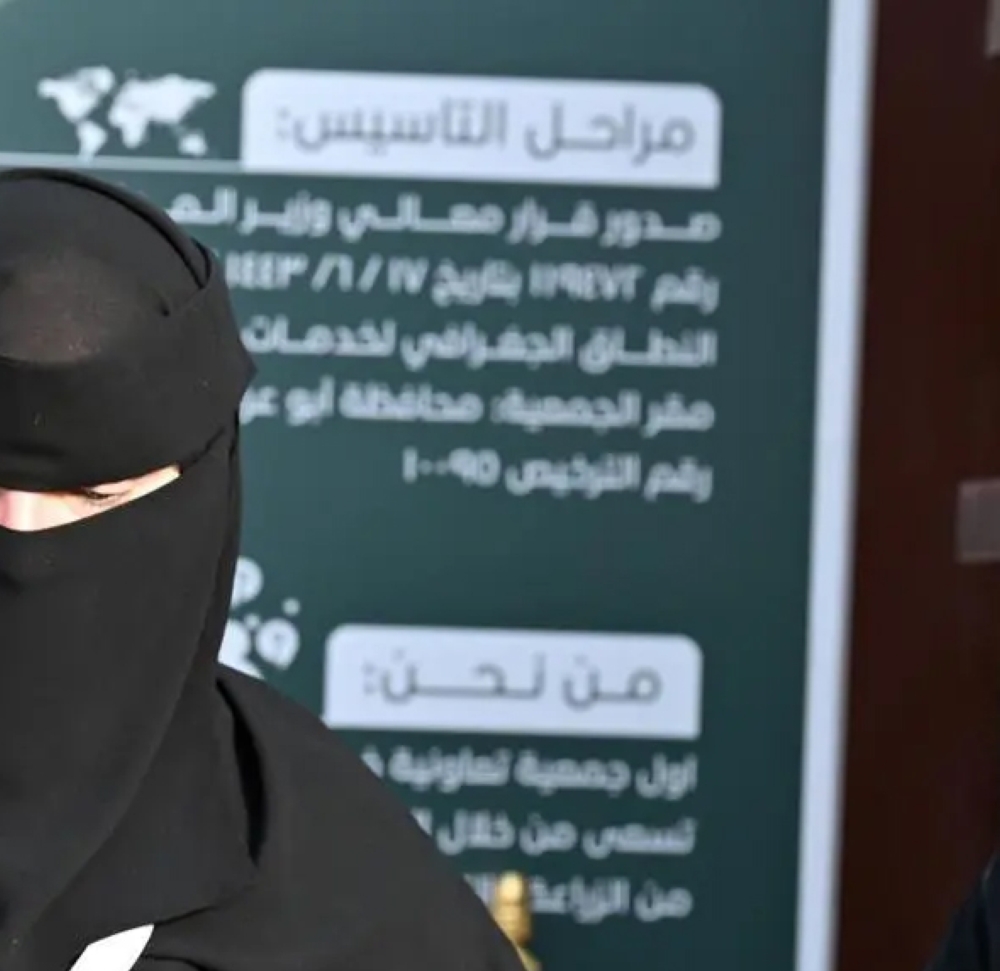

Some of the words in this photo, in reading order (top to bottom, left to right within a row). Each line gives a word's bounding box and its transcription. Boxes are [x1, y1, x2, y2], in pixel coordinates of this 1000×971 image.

[524, 103, 697, 168] مراحل
[651, 267, 719, 313] رقم
[339, 382, 483, 422] محافظة
[640, 393, 715, 437] مقر
[505, 454, 641, 499] الترخيص
[644, 457, 712, 502] رقم
[561, 658, 663, 712] من
[514, 750, 631, 795] جمعية
[520, 815, 577, 855] من
[634, 883, 692, 921] من
